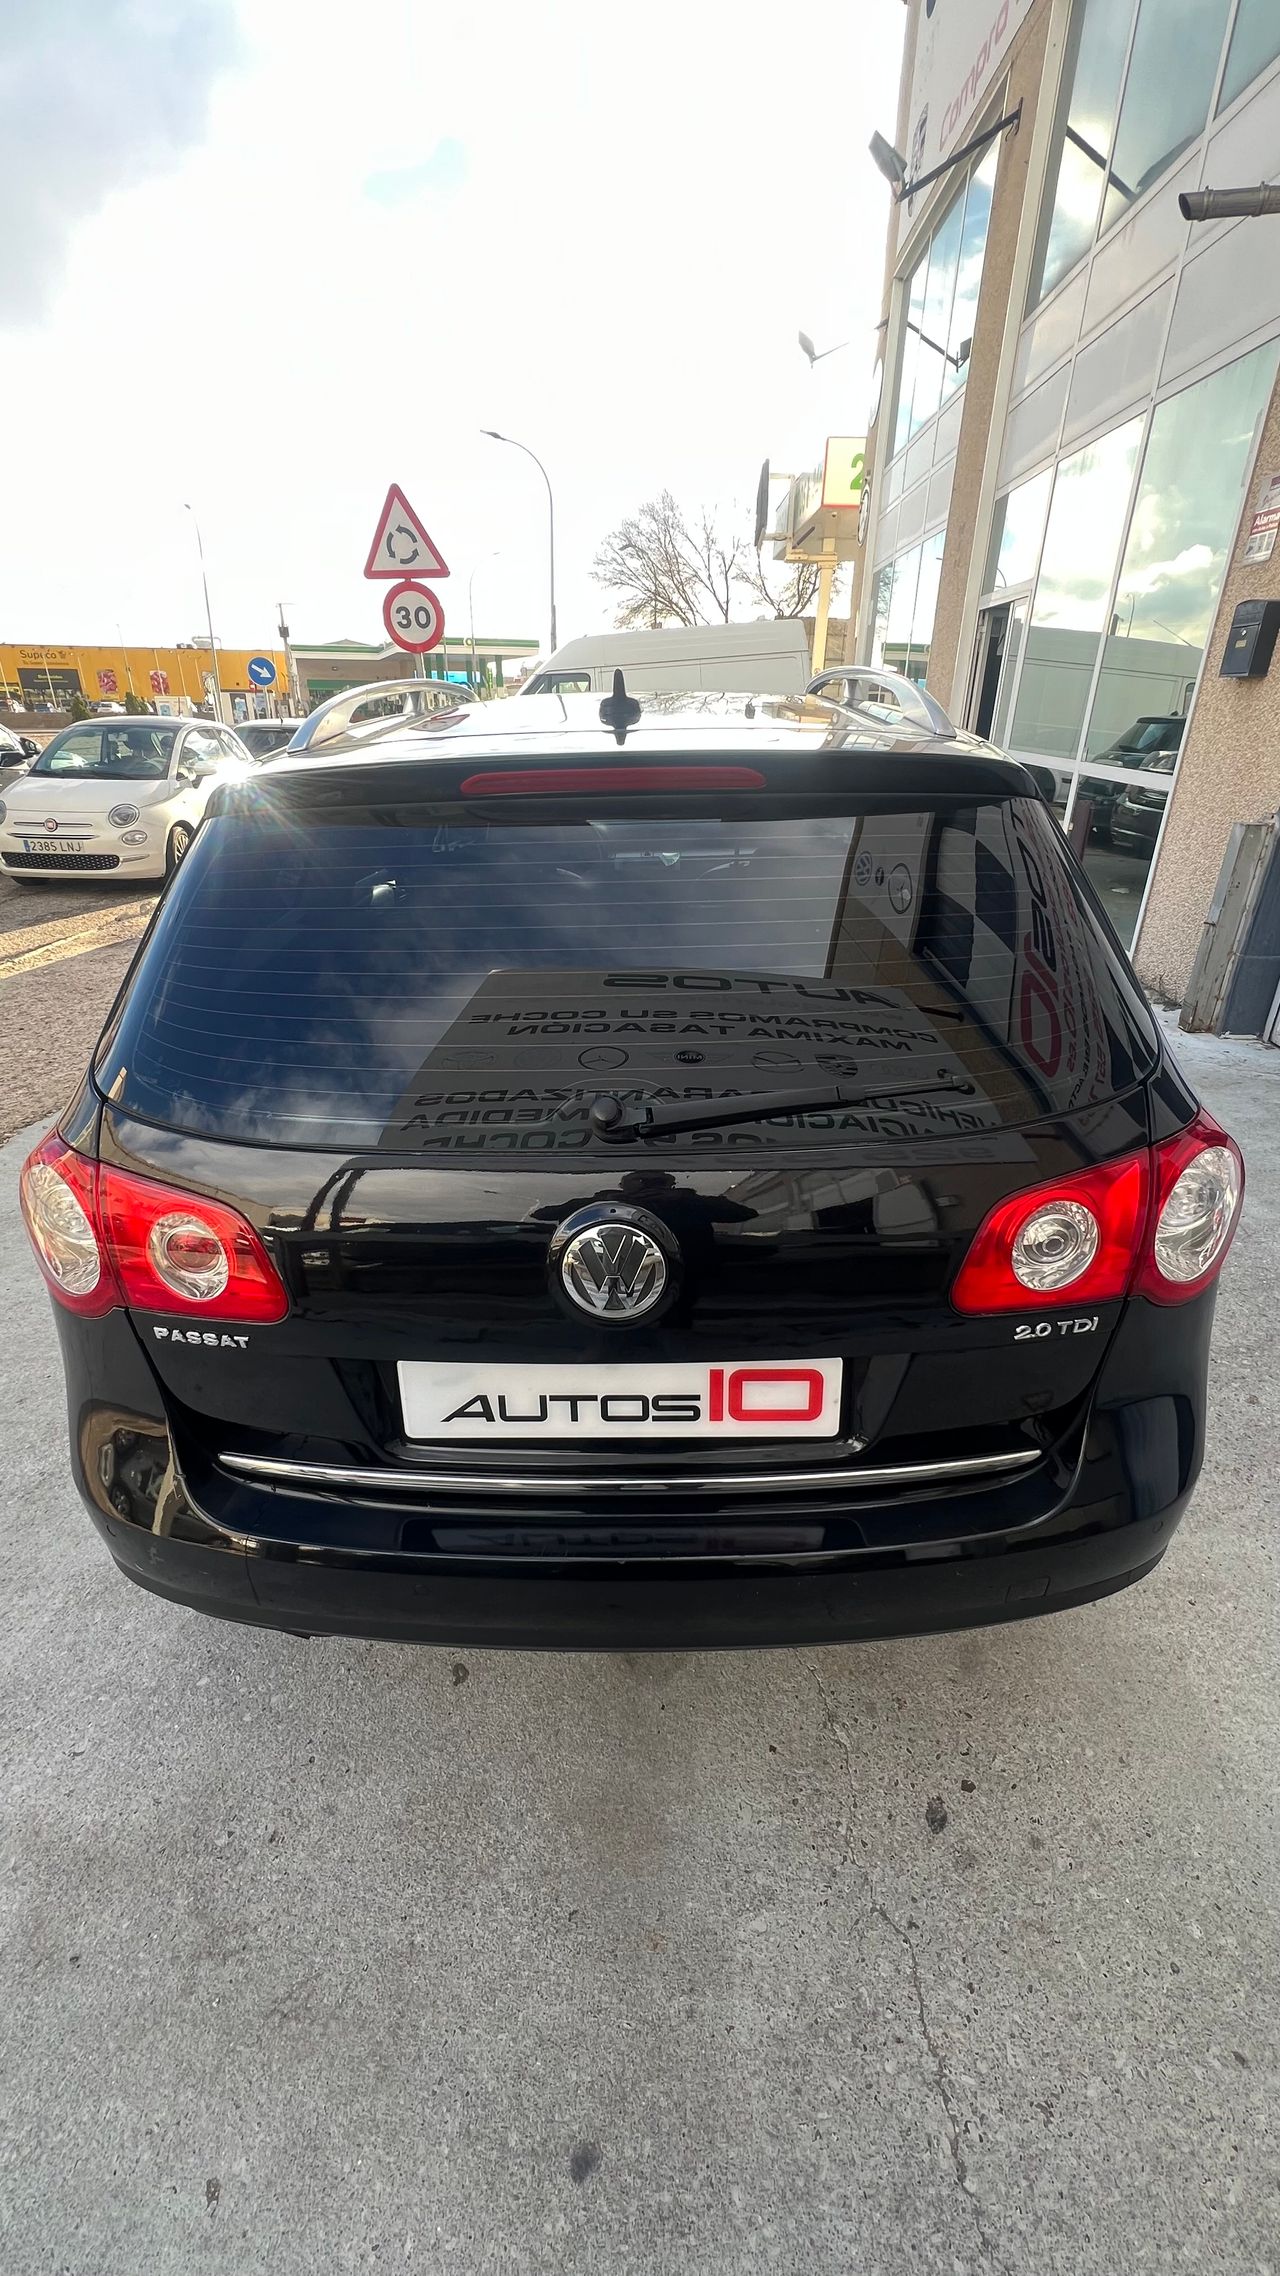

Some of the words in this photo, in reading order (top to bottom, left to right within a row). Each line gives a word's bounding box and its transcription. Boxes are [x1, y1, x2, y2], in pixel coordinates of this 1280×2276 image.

[395, 606, 431, 629] 30
[30, 841, 57, 852] 2385
[60, 842, 81, 852] LNJ
[153, 1326, 250, 1349] PASSAT
[1014, 1322, 1052, 1340] 2.0
[1057, 1316, 1099, 1335] TDI
